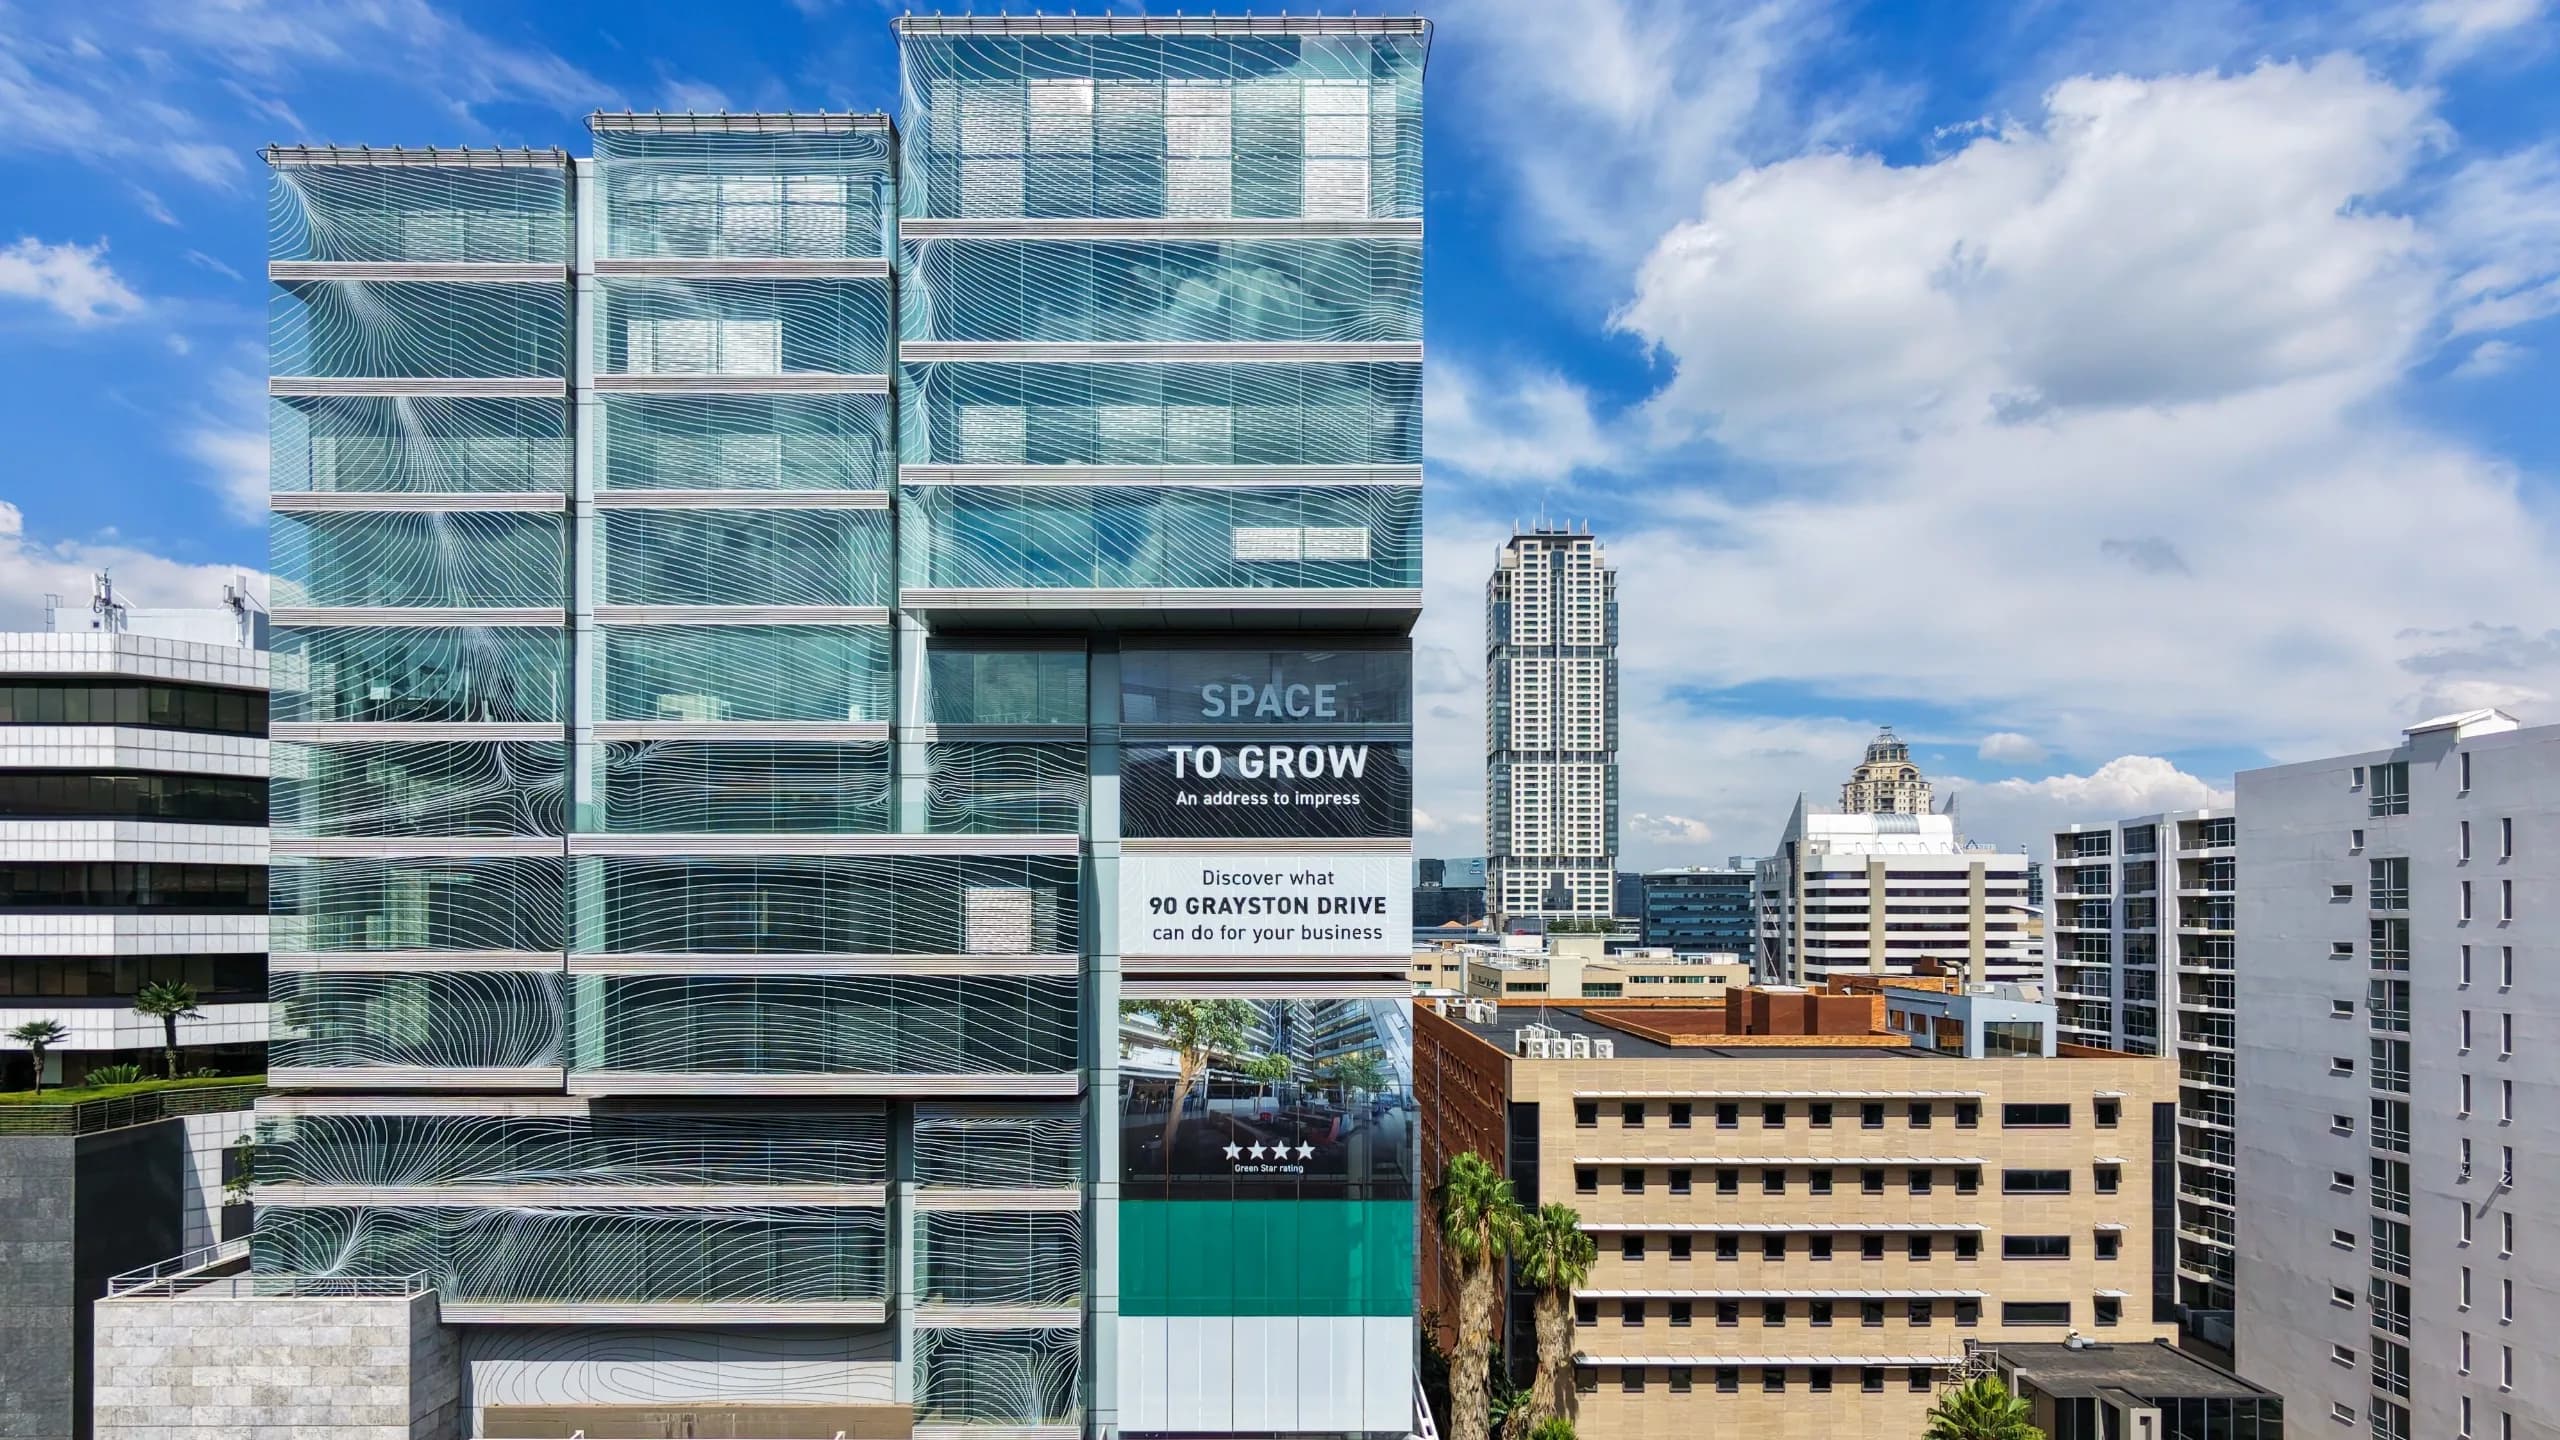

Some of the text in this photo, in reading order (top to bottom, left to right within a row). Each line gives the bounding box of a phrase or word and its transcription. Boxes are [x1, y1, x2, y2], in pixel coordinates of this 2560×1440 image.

[1201, 684, 1337, 718] SPACE
[1167, 745, 1369, 779] TO GROW
[1175, 790, 1361, 809] An address to impress
[1203, 869, 1335, 886] Discover what
[1149, 896, 1387, 915] 90 GRAYSTON DRIVE
[1152, 924, 1383, 944] can do for your business
[1234, 1163, 1304, 1174] Green Star rating
